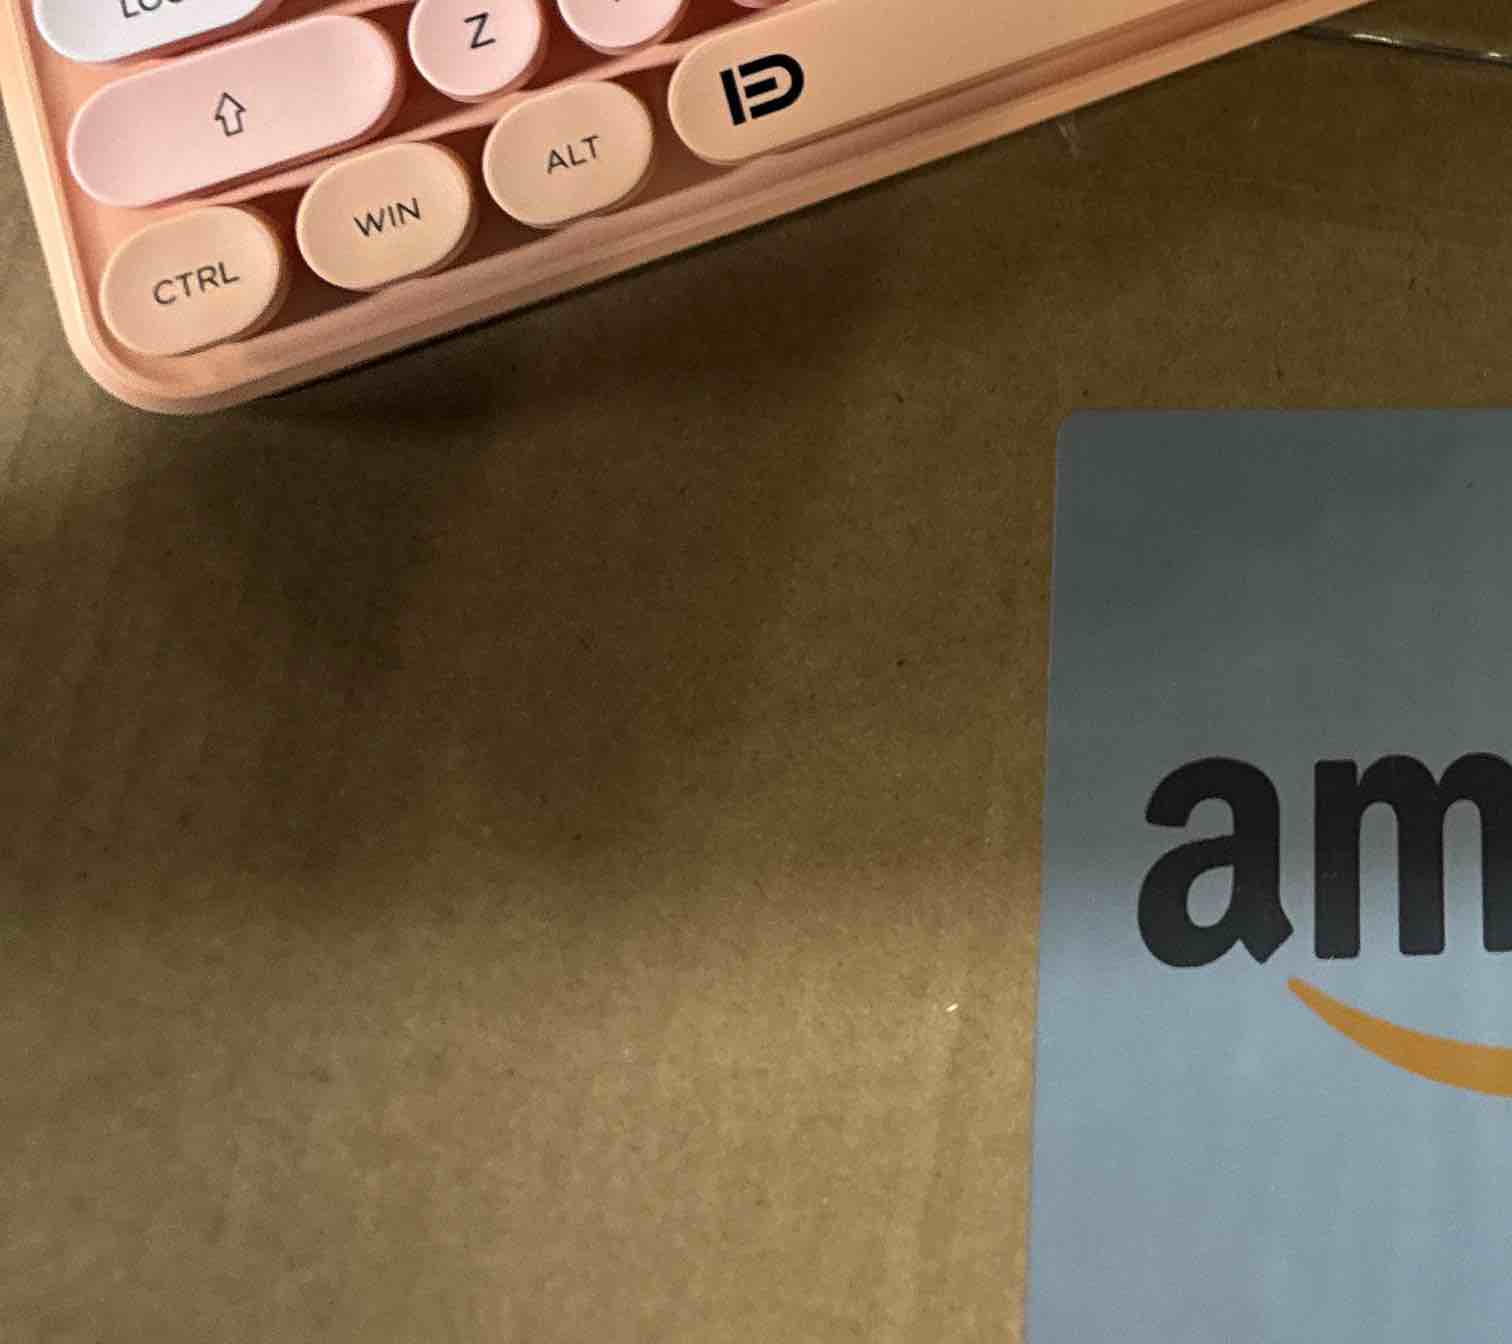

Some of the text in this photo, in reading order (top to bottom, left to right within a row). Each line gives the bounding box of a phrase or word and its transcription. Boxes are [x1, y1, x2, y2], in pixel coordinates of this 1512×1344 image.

[463, 12, 496, 50] Z
[547, 135, 599, 175] ALT
[353, 197, 421, 237] WIN
[153, 261, 241, 305] CTRL
